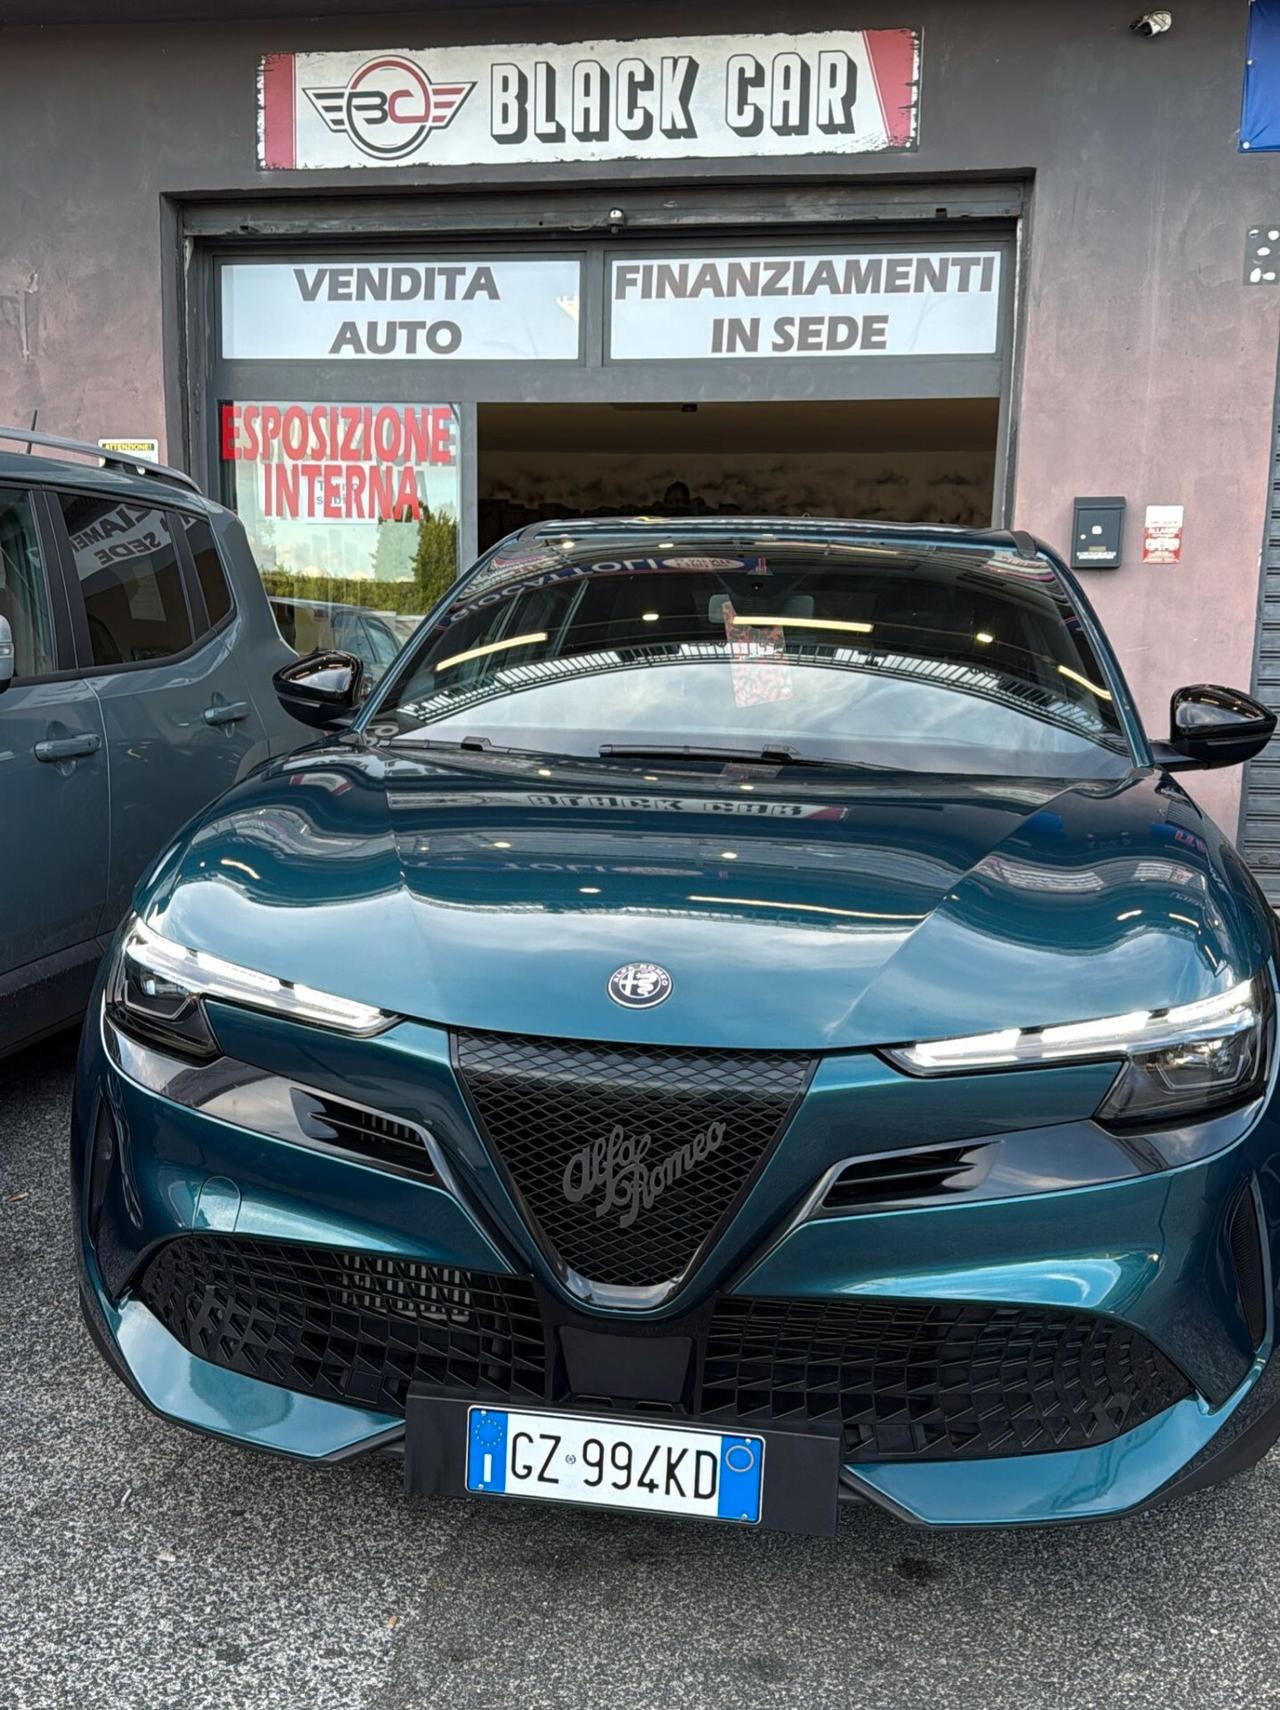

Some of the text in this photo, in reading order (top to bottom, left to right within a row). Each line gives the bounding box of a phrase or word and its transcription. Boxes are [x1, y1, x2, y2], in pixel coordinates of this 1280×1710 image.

[490, 49, 857, 145] BLACK CAR
[294, 266, 501, 302] VENDITA
[614, 256, 995, 300] FINANZIAMENTI
[328, 320, 462, 355] AUTO
[711, 314, 889, 353] IN SEDE
[222, 404, 452, 462] ESPOSIZIONE
[264, 464, 421, 521] INTERNA
[612, 1121, 727, 1229] Romeo
[511, 1431, 562, 1484] GZ
[582, 1438, 718, 1500] 994KD
